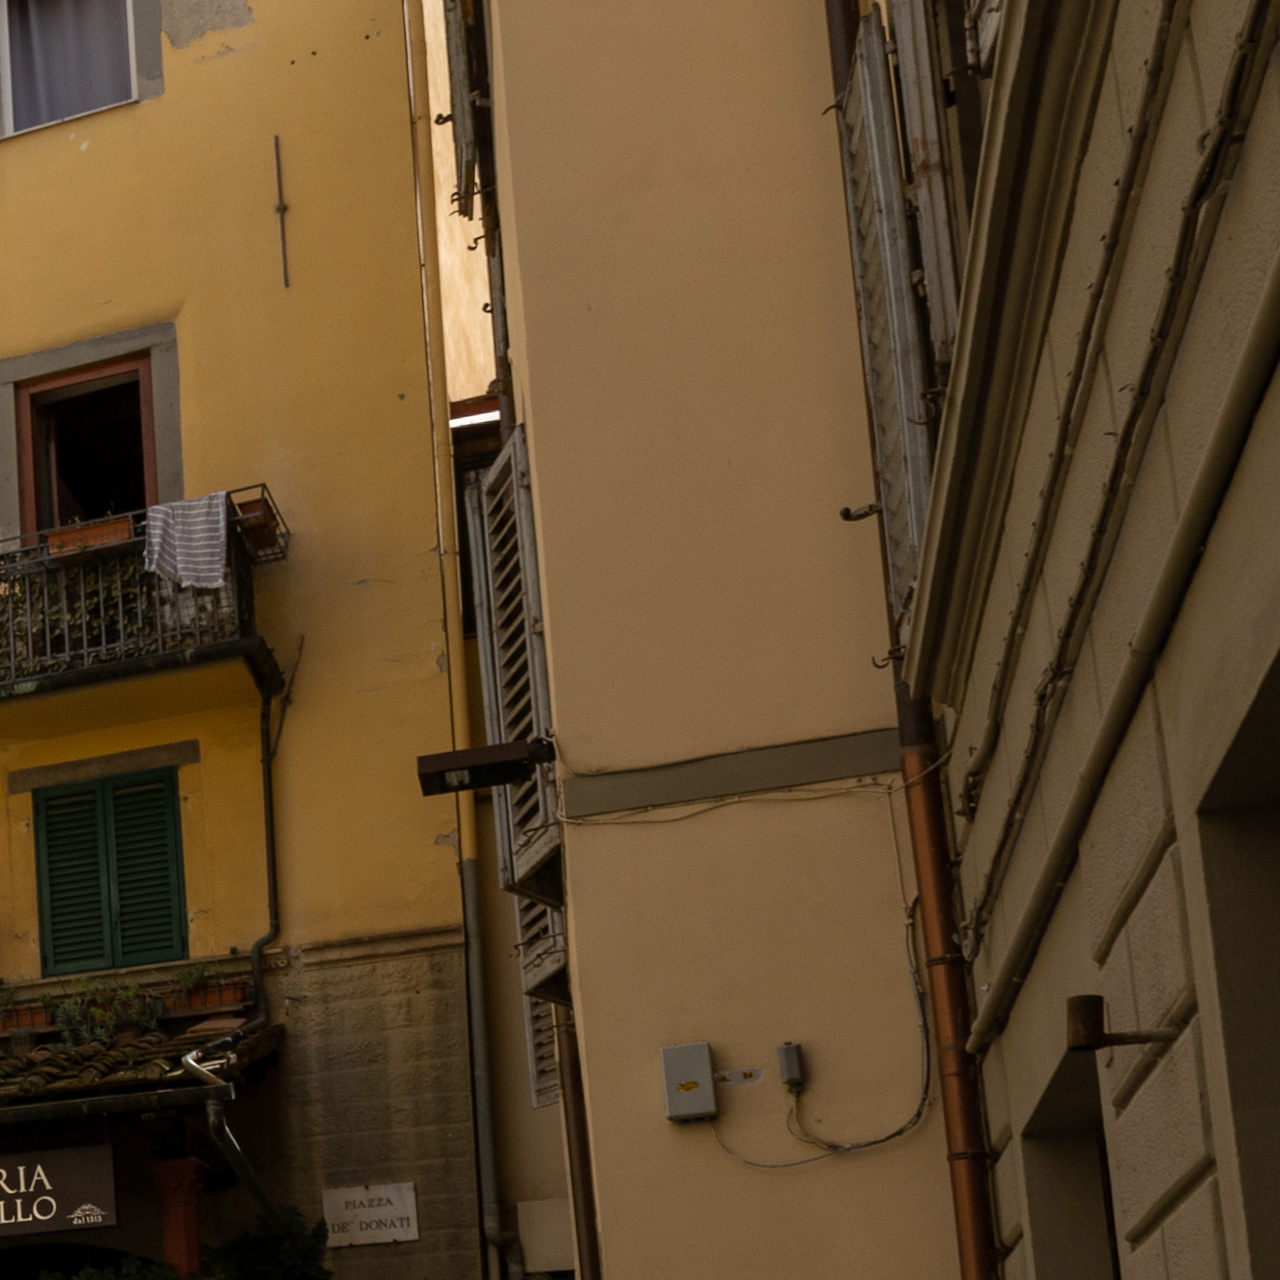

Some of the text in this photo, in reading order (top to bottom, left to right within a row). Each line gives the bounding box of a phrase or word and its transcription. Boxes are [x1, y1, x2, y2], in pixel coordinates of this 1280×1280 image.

[344, 1197, 394, 1210] PIAZZA
[332, 1216, 411, 1234] DE' DONATI
